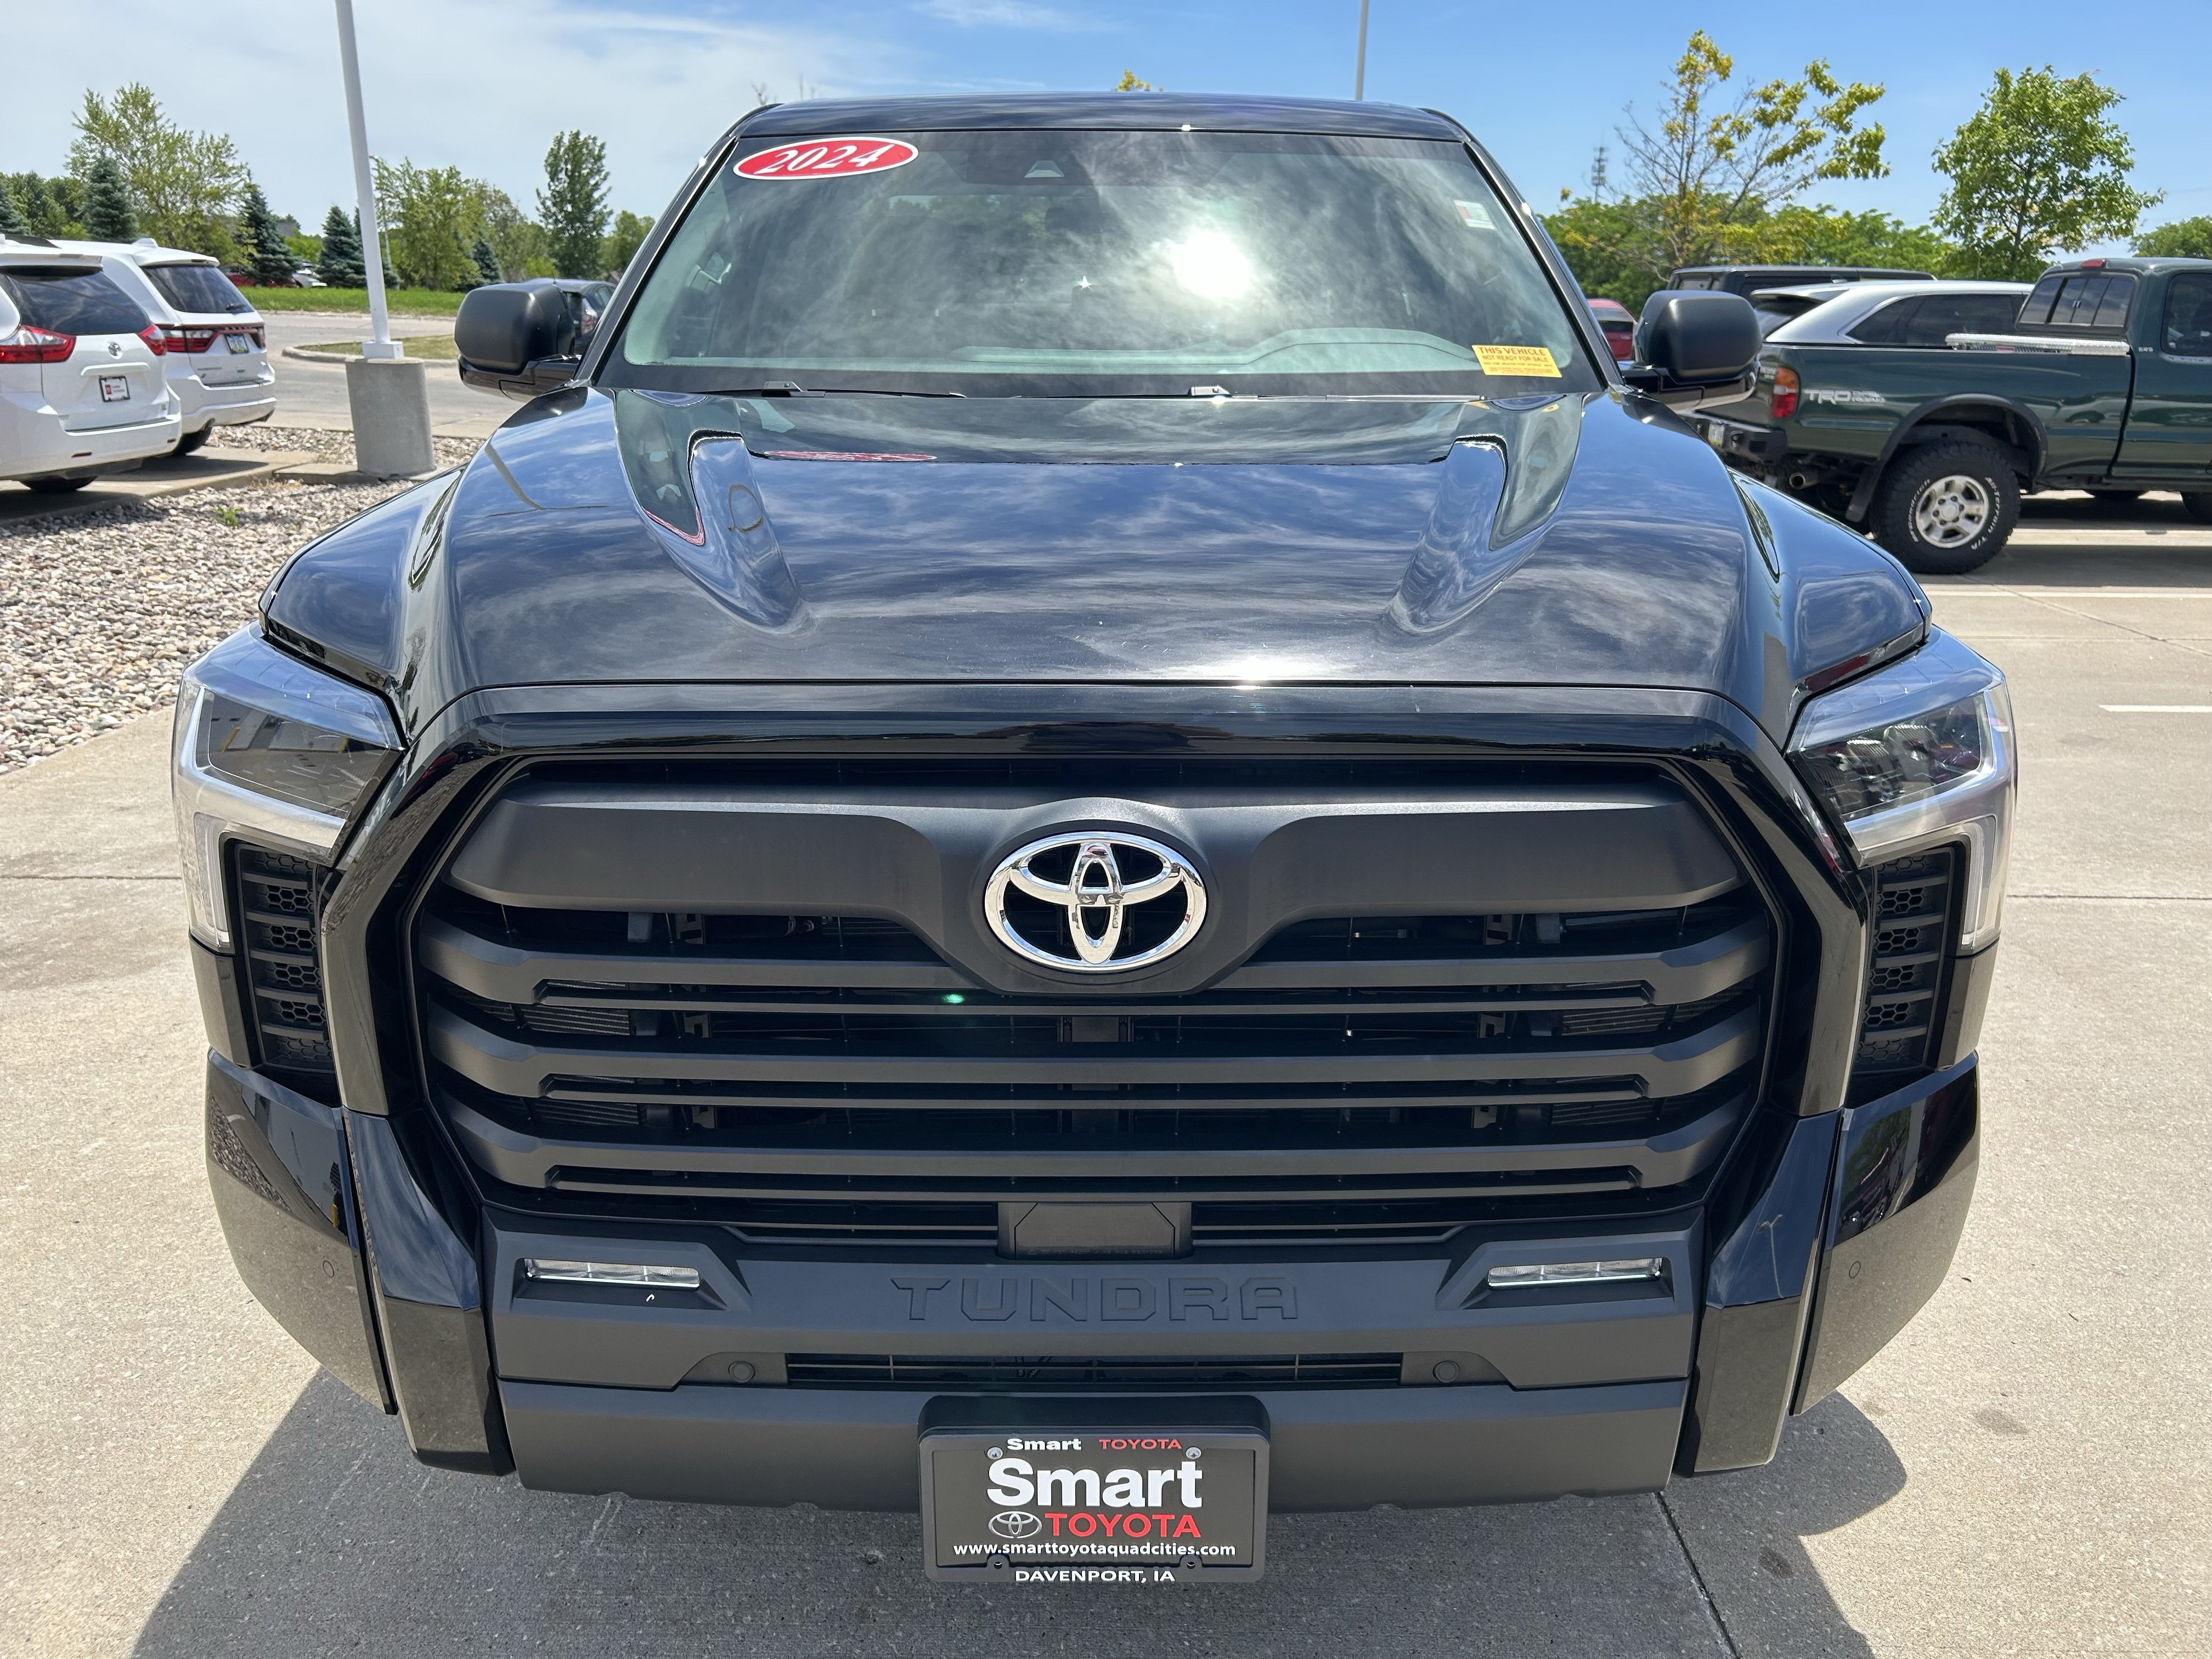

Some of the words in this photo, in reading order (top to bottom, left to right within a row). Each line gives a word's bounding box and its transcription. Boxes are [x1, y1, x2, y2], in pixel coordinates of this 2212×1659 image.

[753, 144, 895, 174] 2024
[1503, 347, 1546, 356] VEHICLE
[1804, 388, 1852, 405] TRD
[1970, 535, 1988, 550] T/A
[890, 1277, 1299, 1321] TUNDRA
[1006, 1437, 1082, 1451] Smart
[1099, 1438, 1183, 1450] TOYOTA
[987, 1458, 1203, 1508] Smart
[1045, 1513, 1201, 1538] TOYOTA
[953, 1542, 1235, 1557] www.smarttoyotaquadcities.com
[1015, 1570, 1147, 1583] DAVENPORT,
[1153, 1570, 1176, 1582] IA
